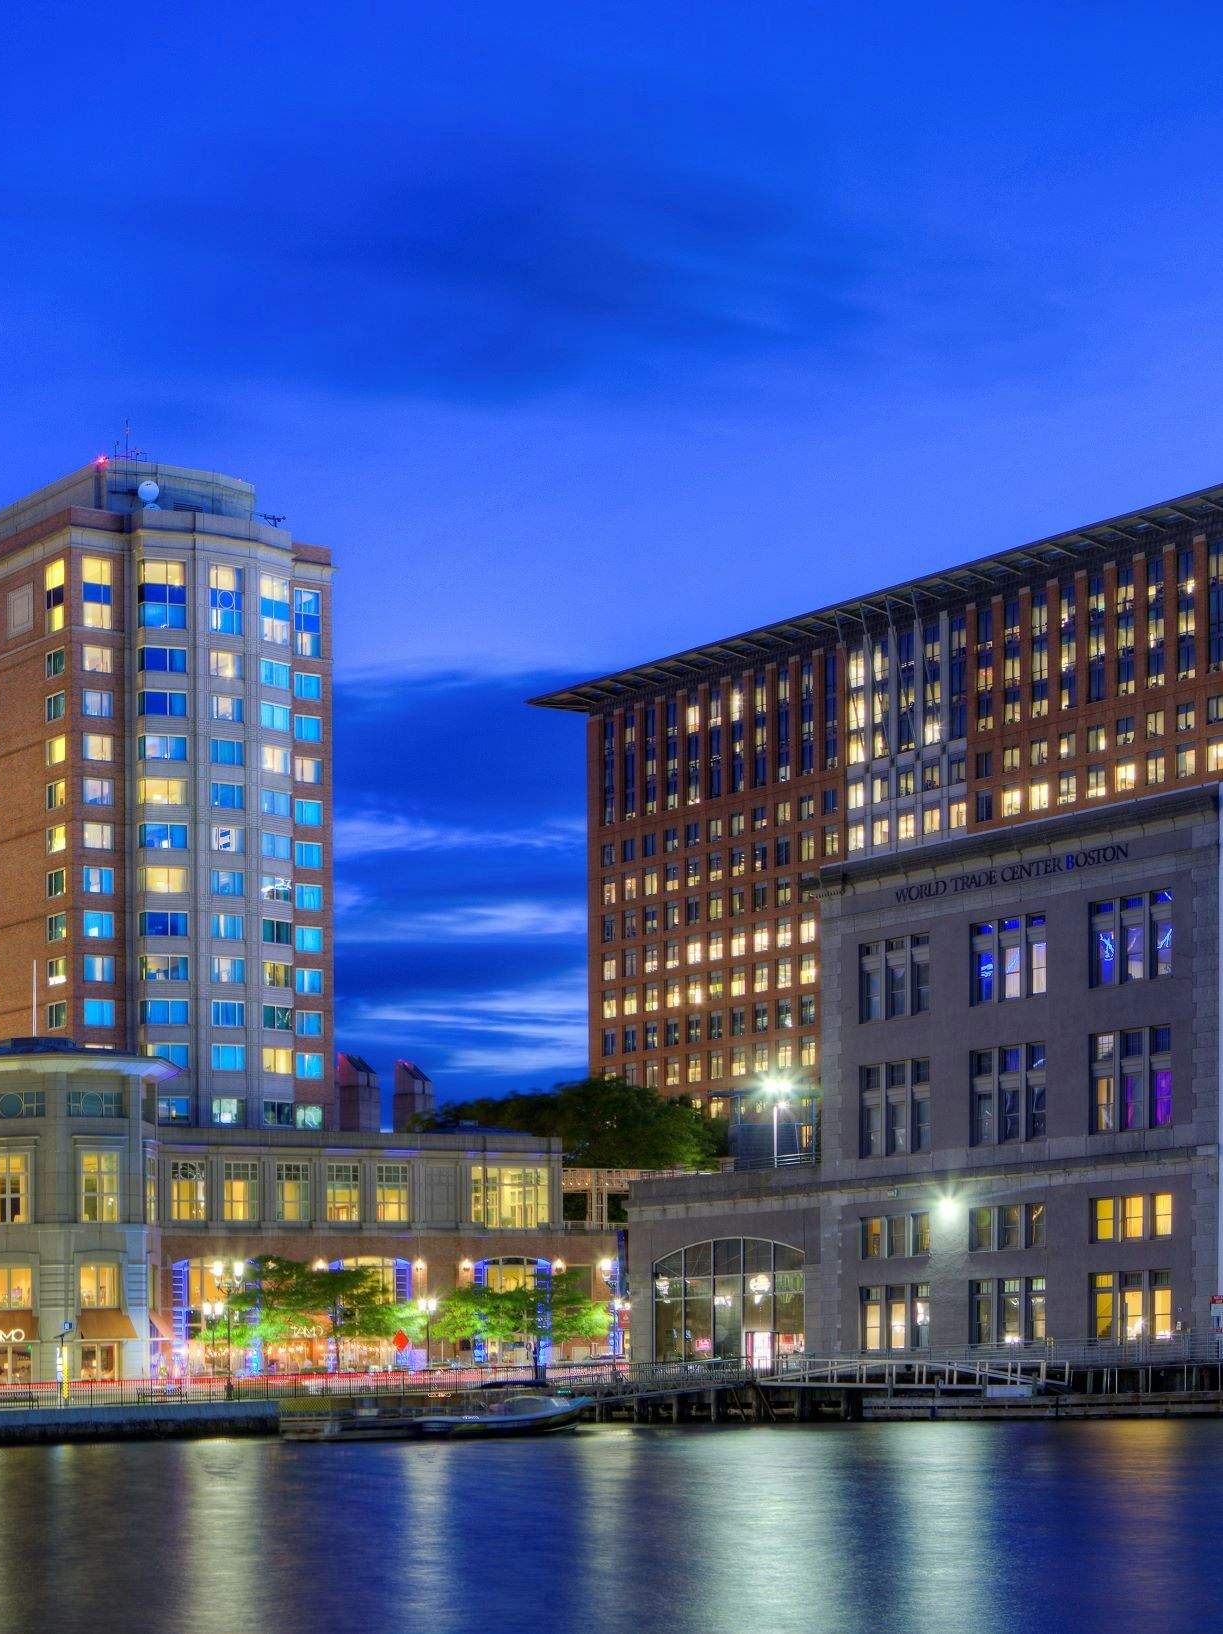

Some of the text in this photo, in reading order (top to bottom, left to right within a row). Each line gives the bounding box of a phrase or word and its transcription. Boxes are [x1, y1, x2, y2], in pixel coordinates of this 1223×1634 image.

[895, 843, 1129, 903] WORLD TRADE CENTER BOSTON
